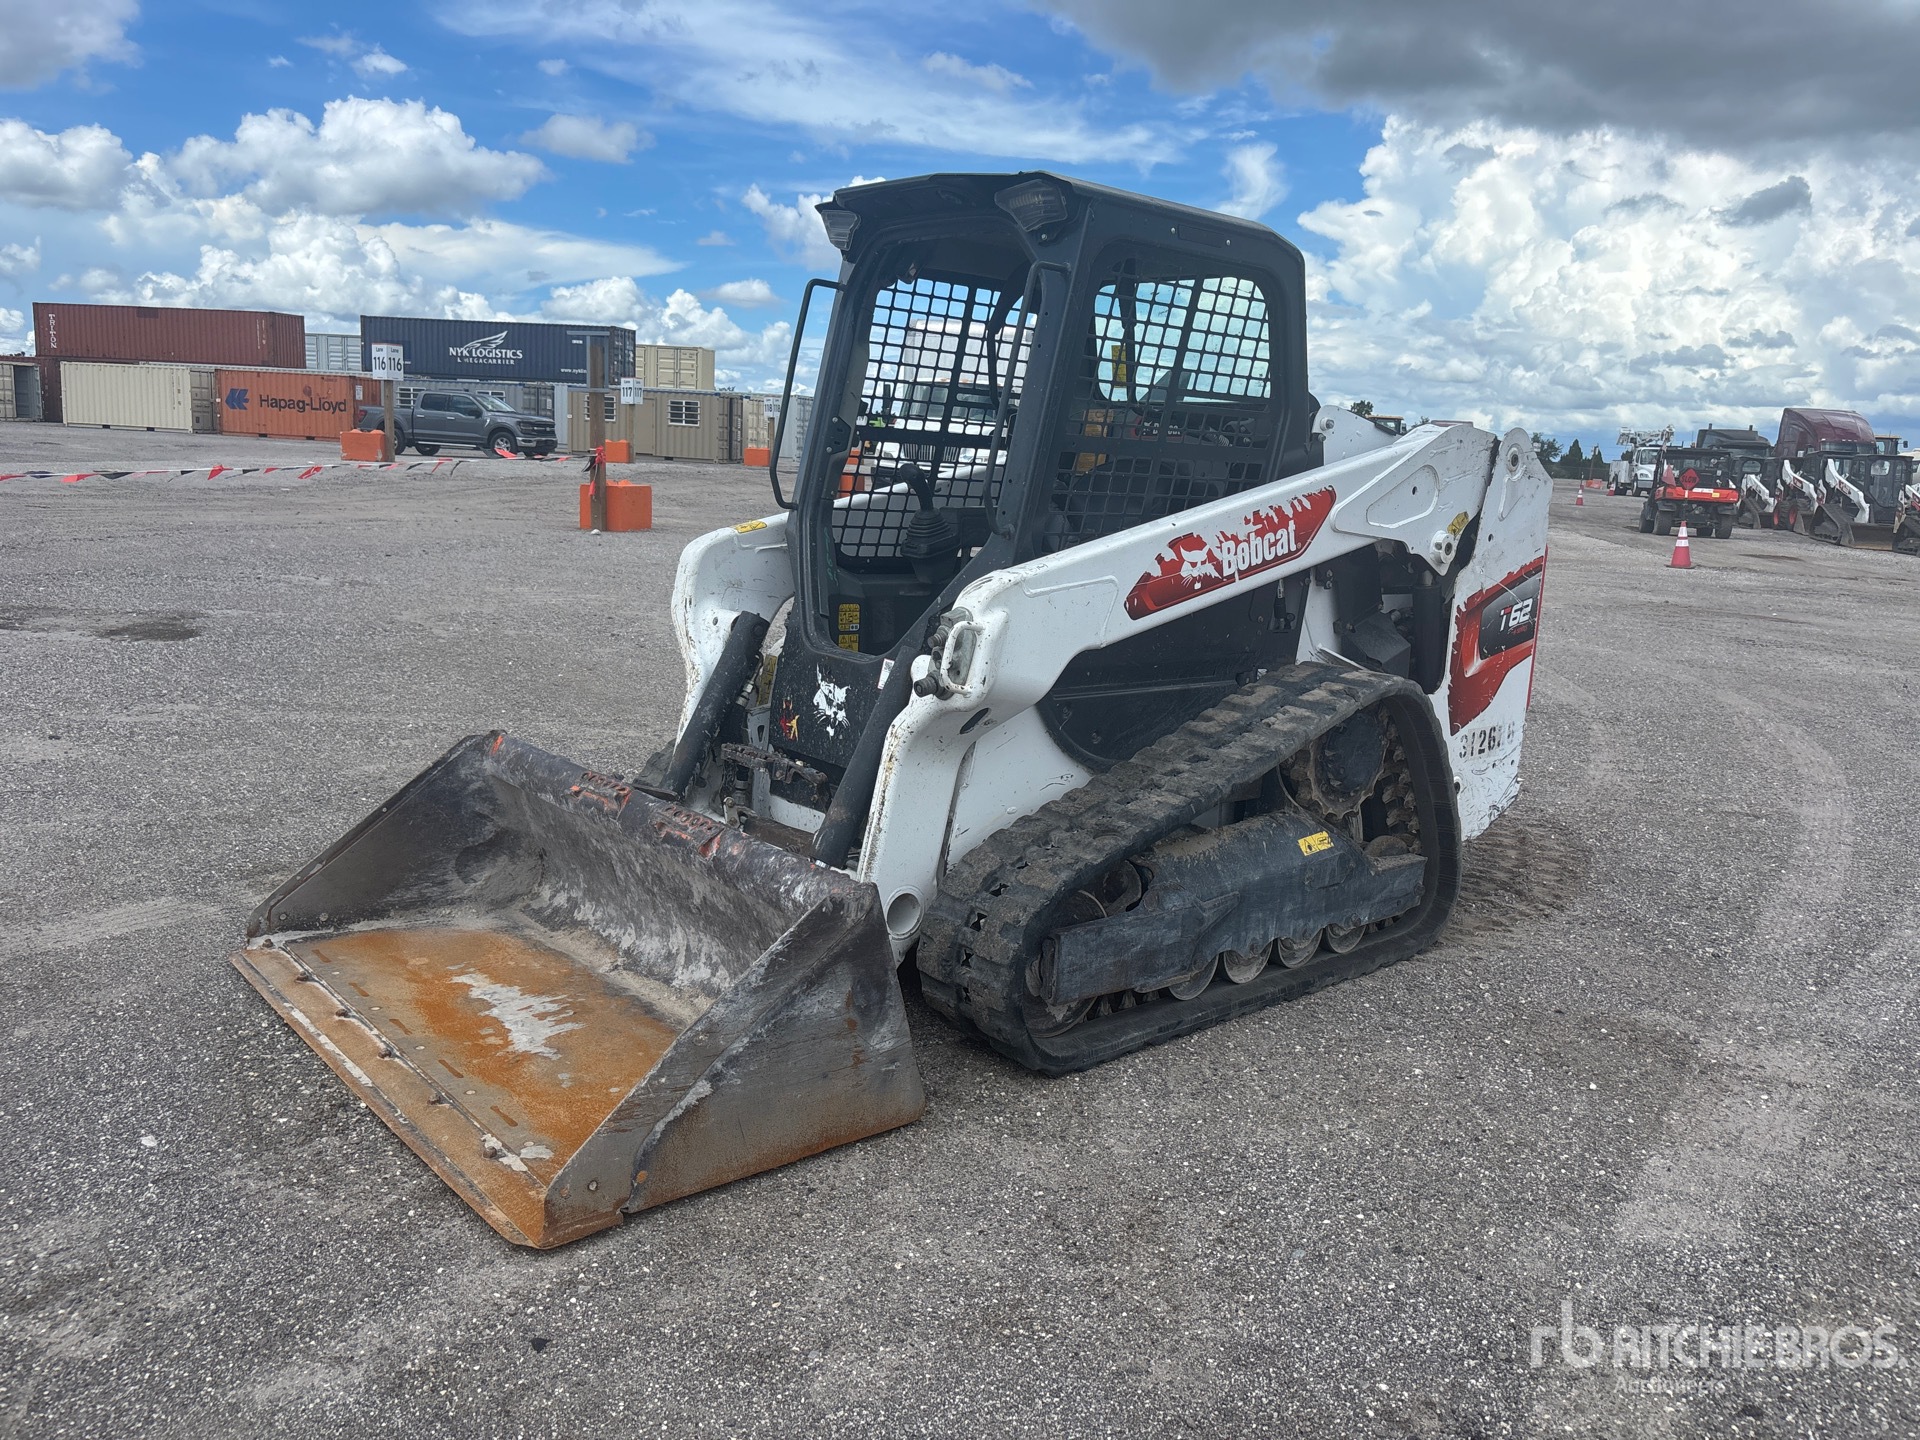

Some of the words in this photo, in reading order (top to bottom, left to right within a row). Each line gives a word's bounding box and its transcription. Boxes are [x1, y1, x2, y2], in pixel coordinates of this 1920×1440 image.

[48, 313, 58, 349] TRITON
[448, 346, 470, 356] NYK
[472, 348, 523, 359] LOGISTICS
[373, 357, 386, 370] 116
[388, 357, 402, 371] 116
[622, 386, 633, 398] 117
[634, 387, 643, 398] 117
[259, 394, 347, 415] Hapag-Lloyd
[1681, 475, 1698, 484] SLOW
[1222, 519, 1297, 577] Bobcat
[1500, 597, 1533, 632] T62
